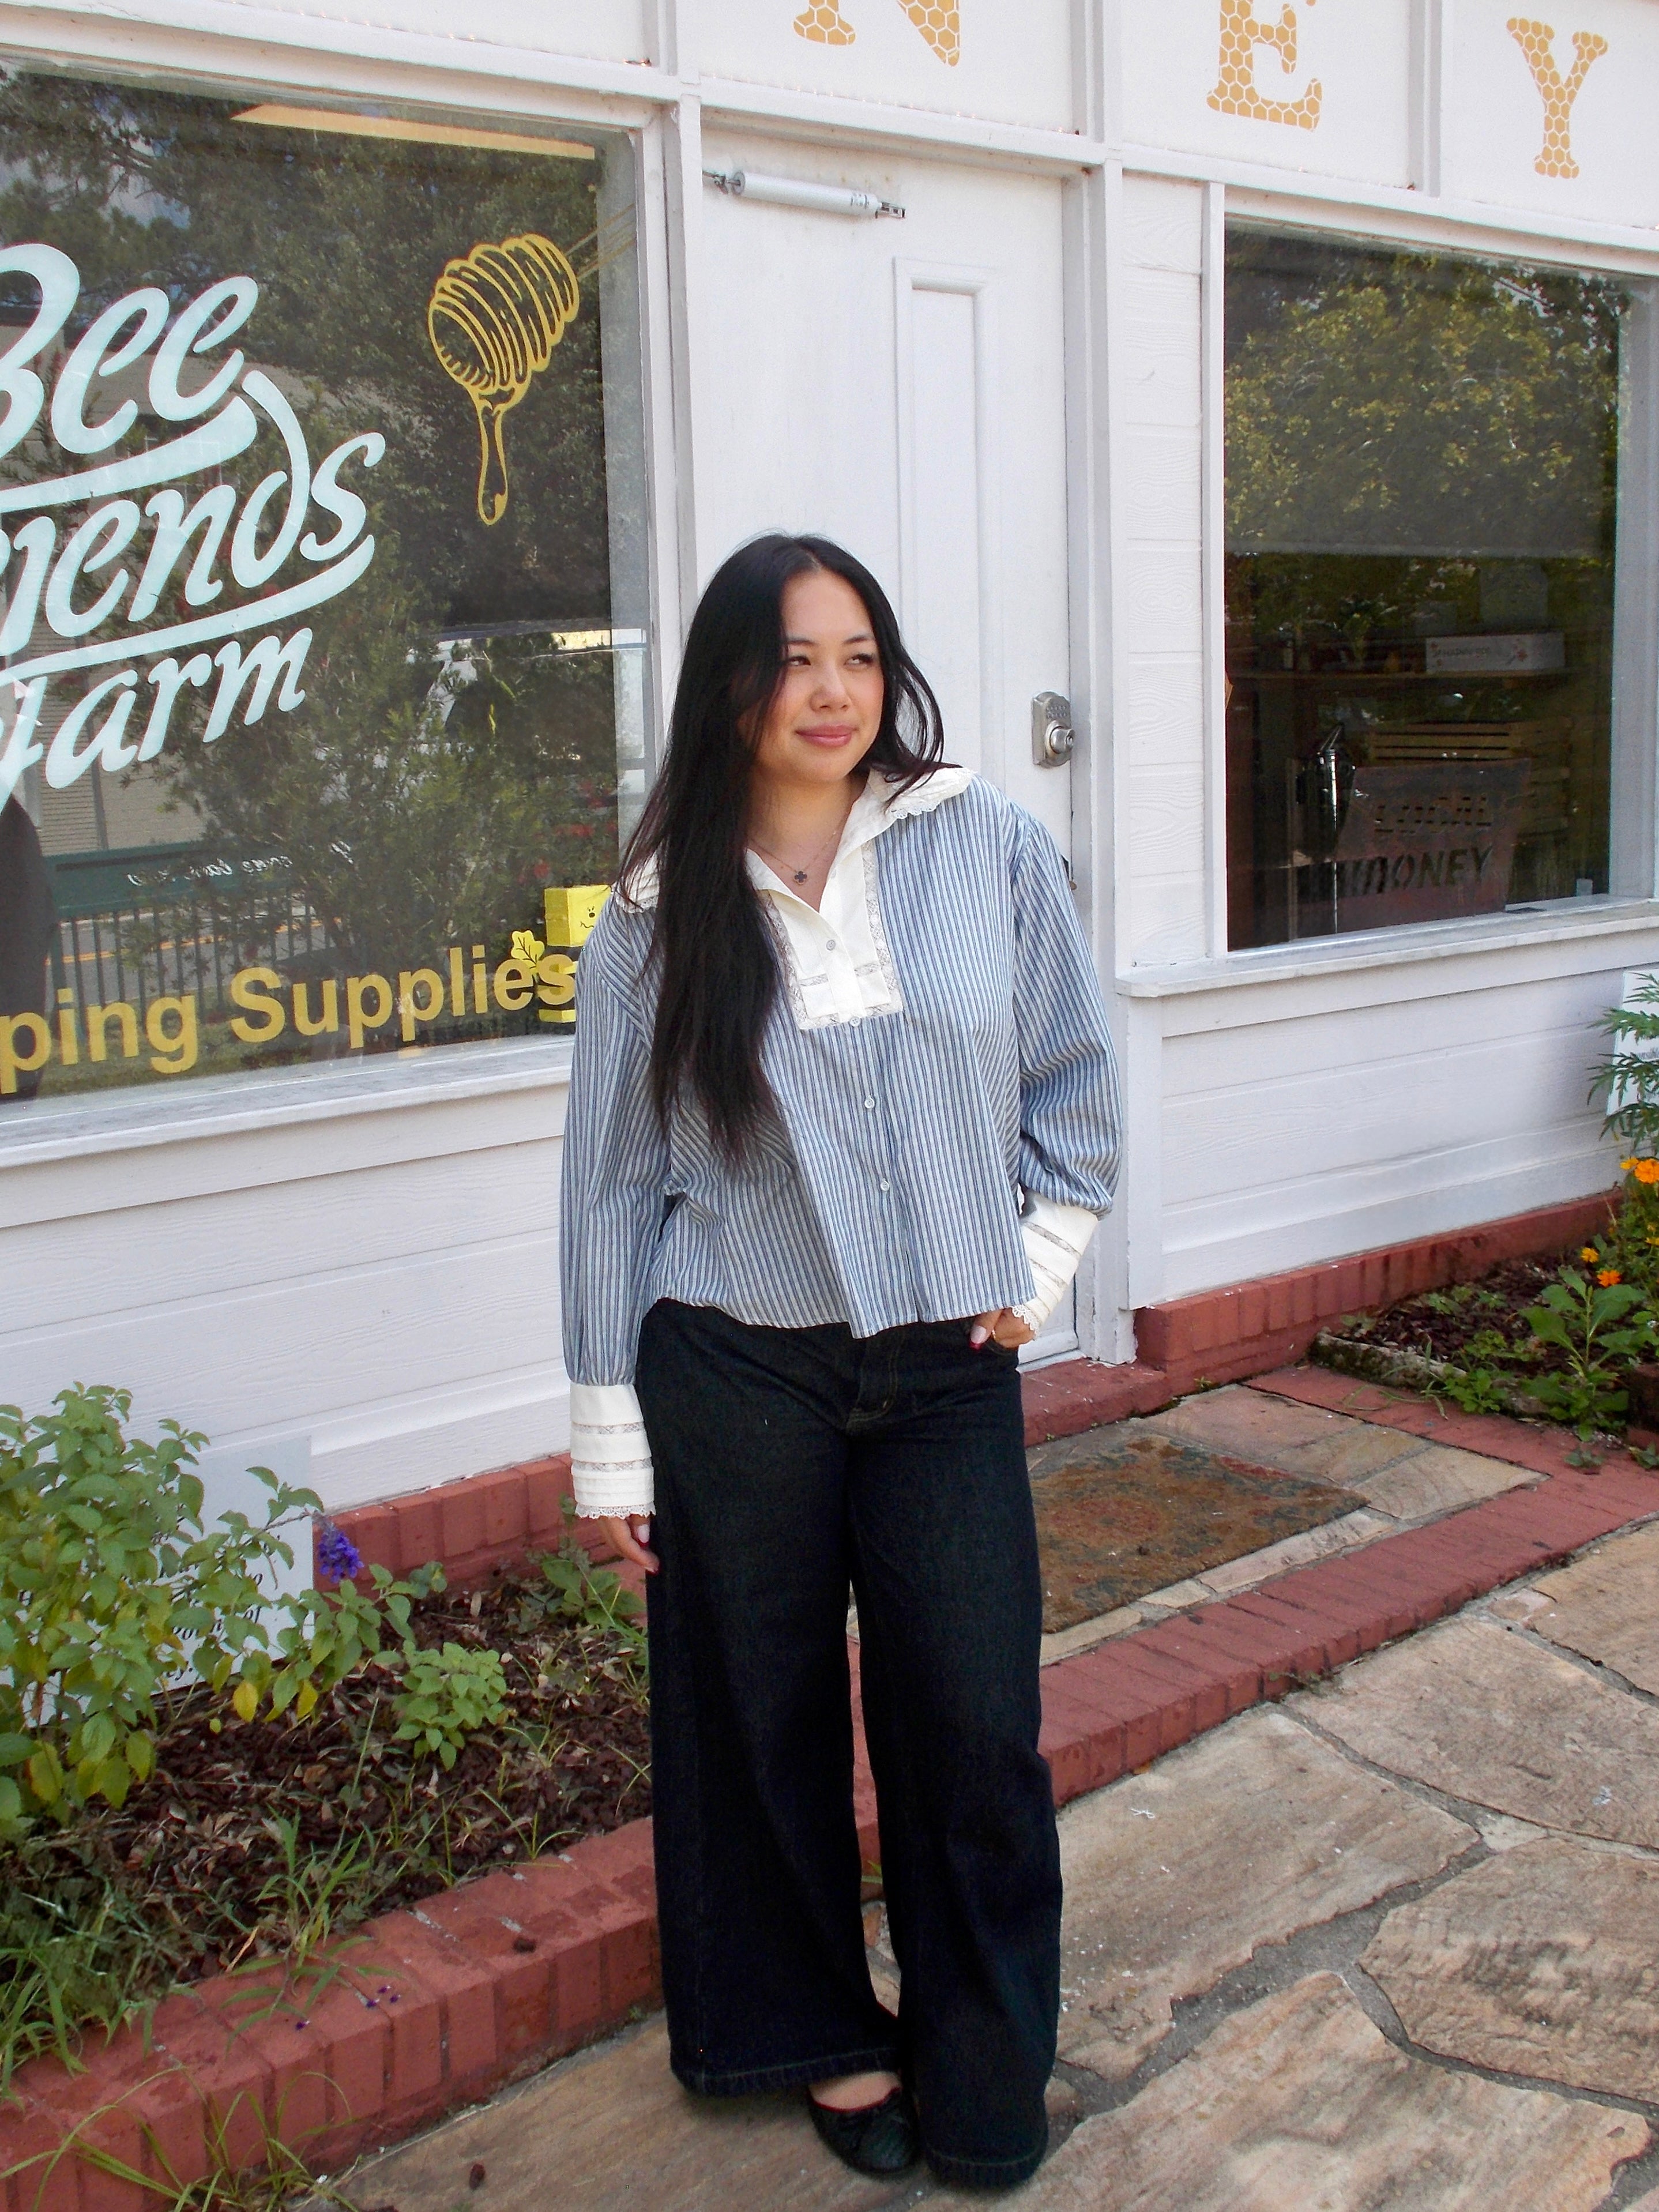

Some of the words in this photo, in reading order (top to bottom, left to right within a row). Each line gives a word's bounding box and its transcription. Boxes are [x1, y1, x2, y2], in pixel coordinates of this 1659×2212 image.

[0, 369, 386, 657] iends
[0, 987, 198, 1094] ping
[230, 945, 575, 1048] Supplies
